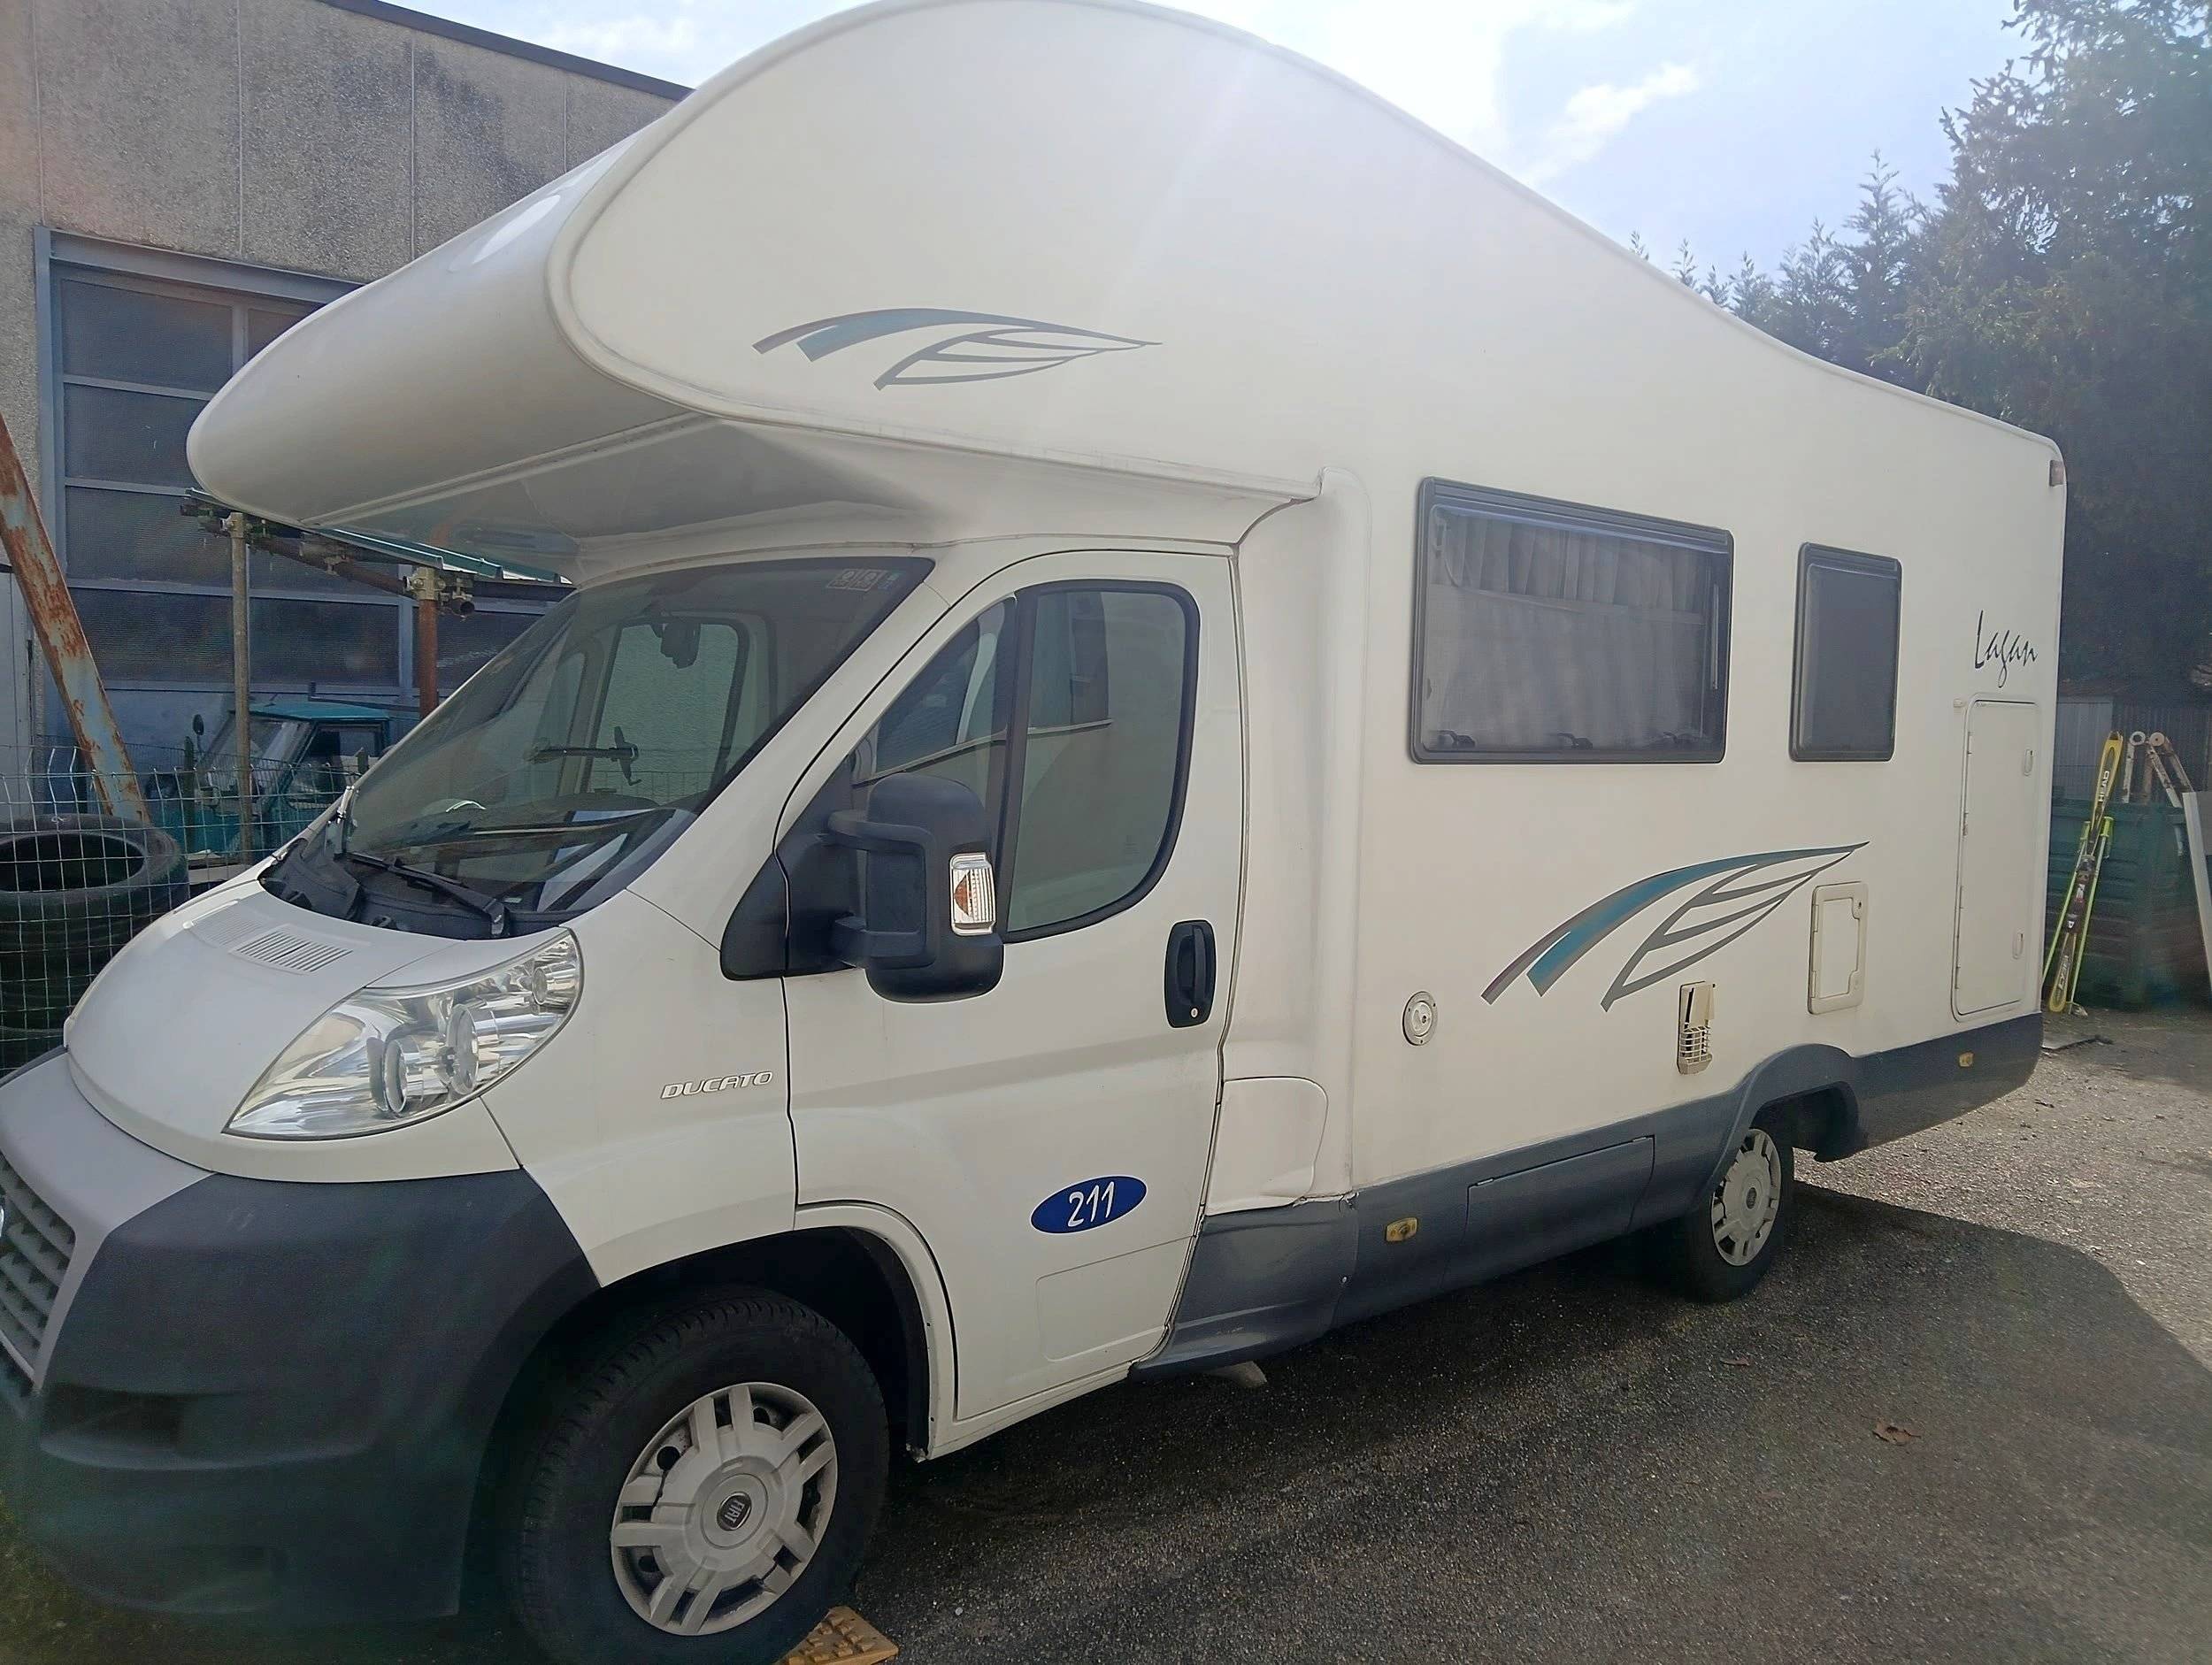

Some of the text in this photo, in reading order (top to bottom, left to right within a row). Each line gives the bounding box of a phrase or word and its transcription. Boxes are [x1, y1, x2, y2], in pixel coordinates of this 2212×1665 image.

[1975, 610, 2039, 688] Lagan
[661, 1071, 773, 1099] DUCATO
[1068, 1181, 1115, 1227] 211
[724, 1500, 745, 1523] FIAT
